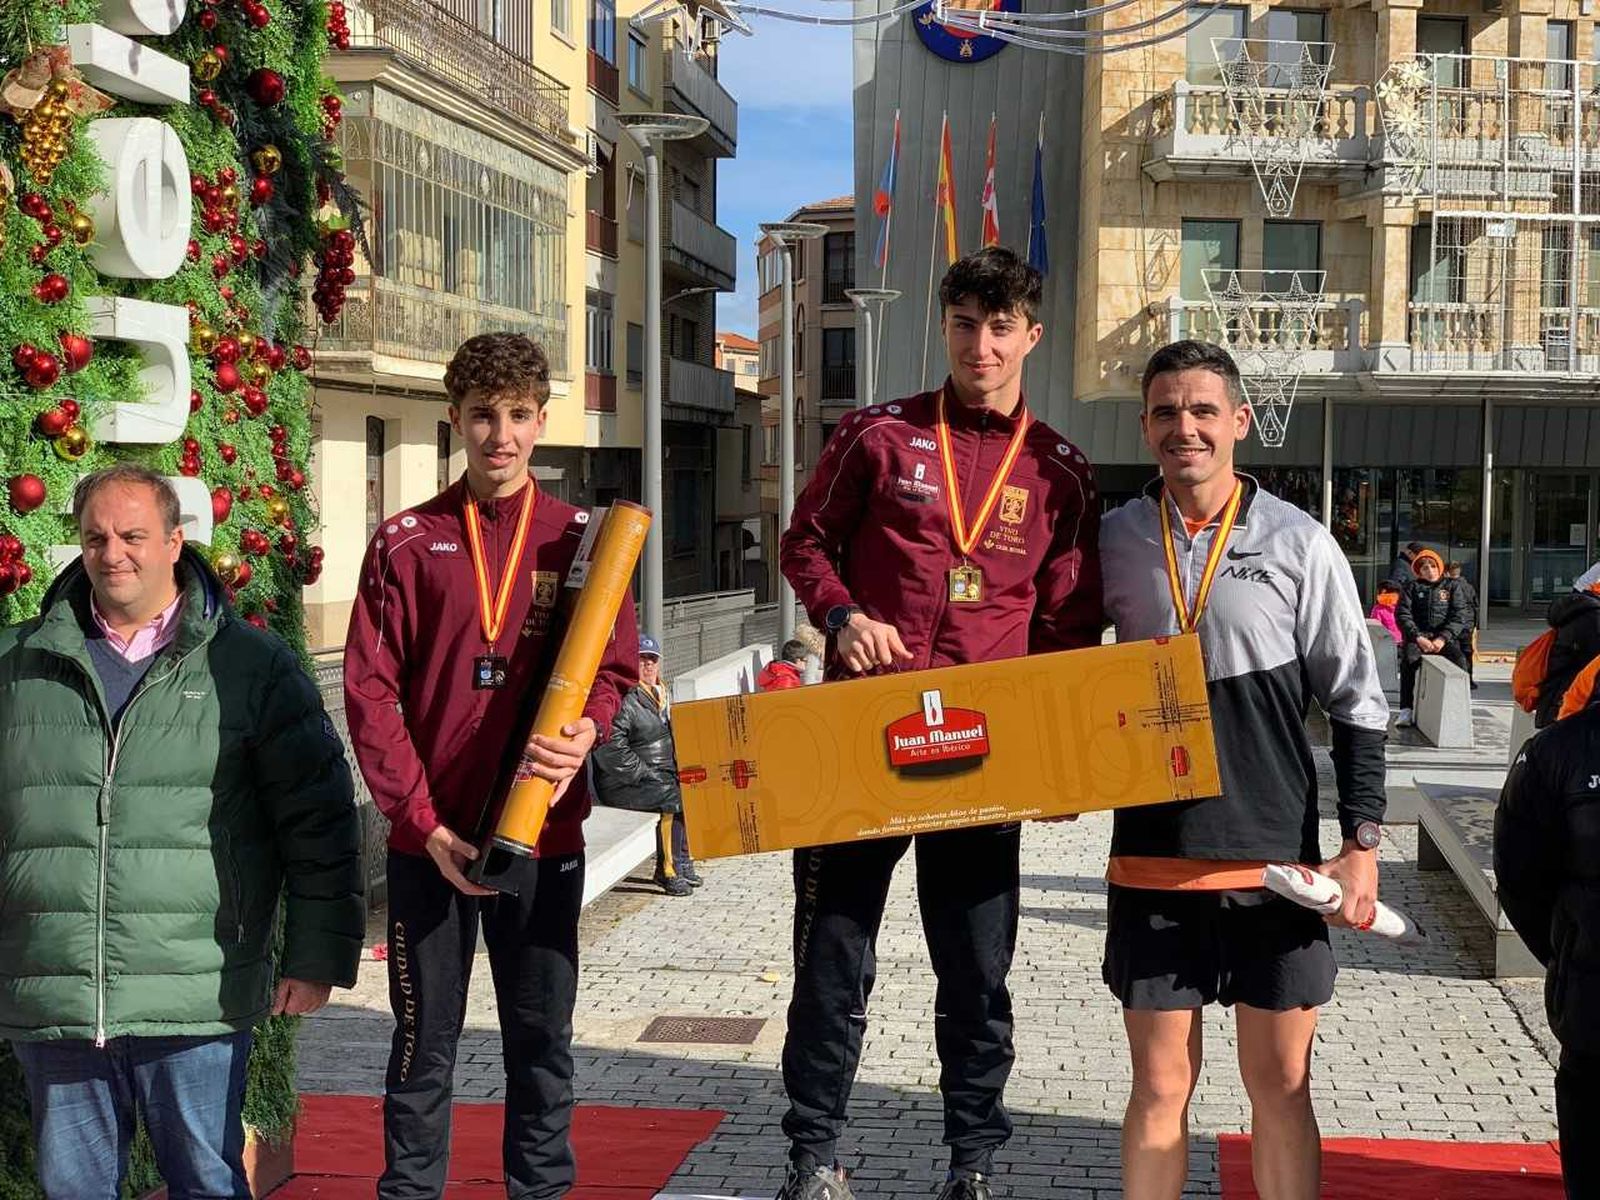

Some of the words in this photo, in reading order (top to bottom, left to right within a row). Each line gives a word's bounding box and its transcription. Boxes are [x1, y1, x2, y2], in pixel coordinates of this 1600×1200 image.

[910, 436, 937, 451] JAKO
[430, 542, 458, 552] JAKO
[1220, 565, 1277, 584] NIKE
[894, 735, 926, 751] Juan
[929, 724, 984, 743] Manuel
[394, 920, 413, 996] CIUDAD
[404, 999, 415, 1026] DE
[400, 1028, 416, 1083] TORO
